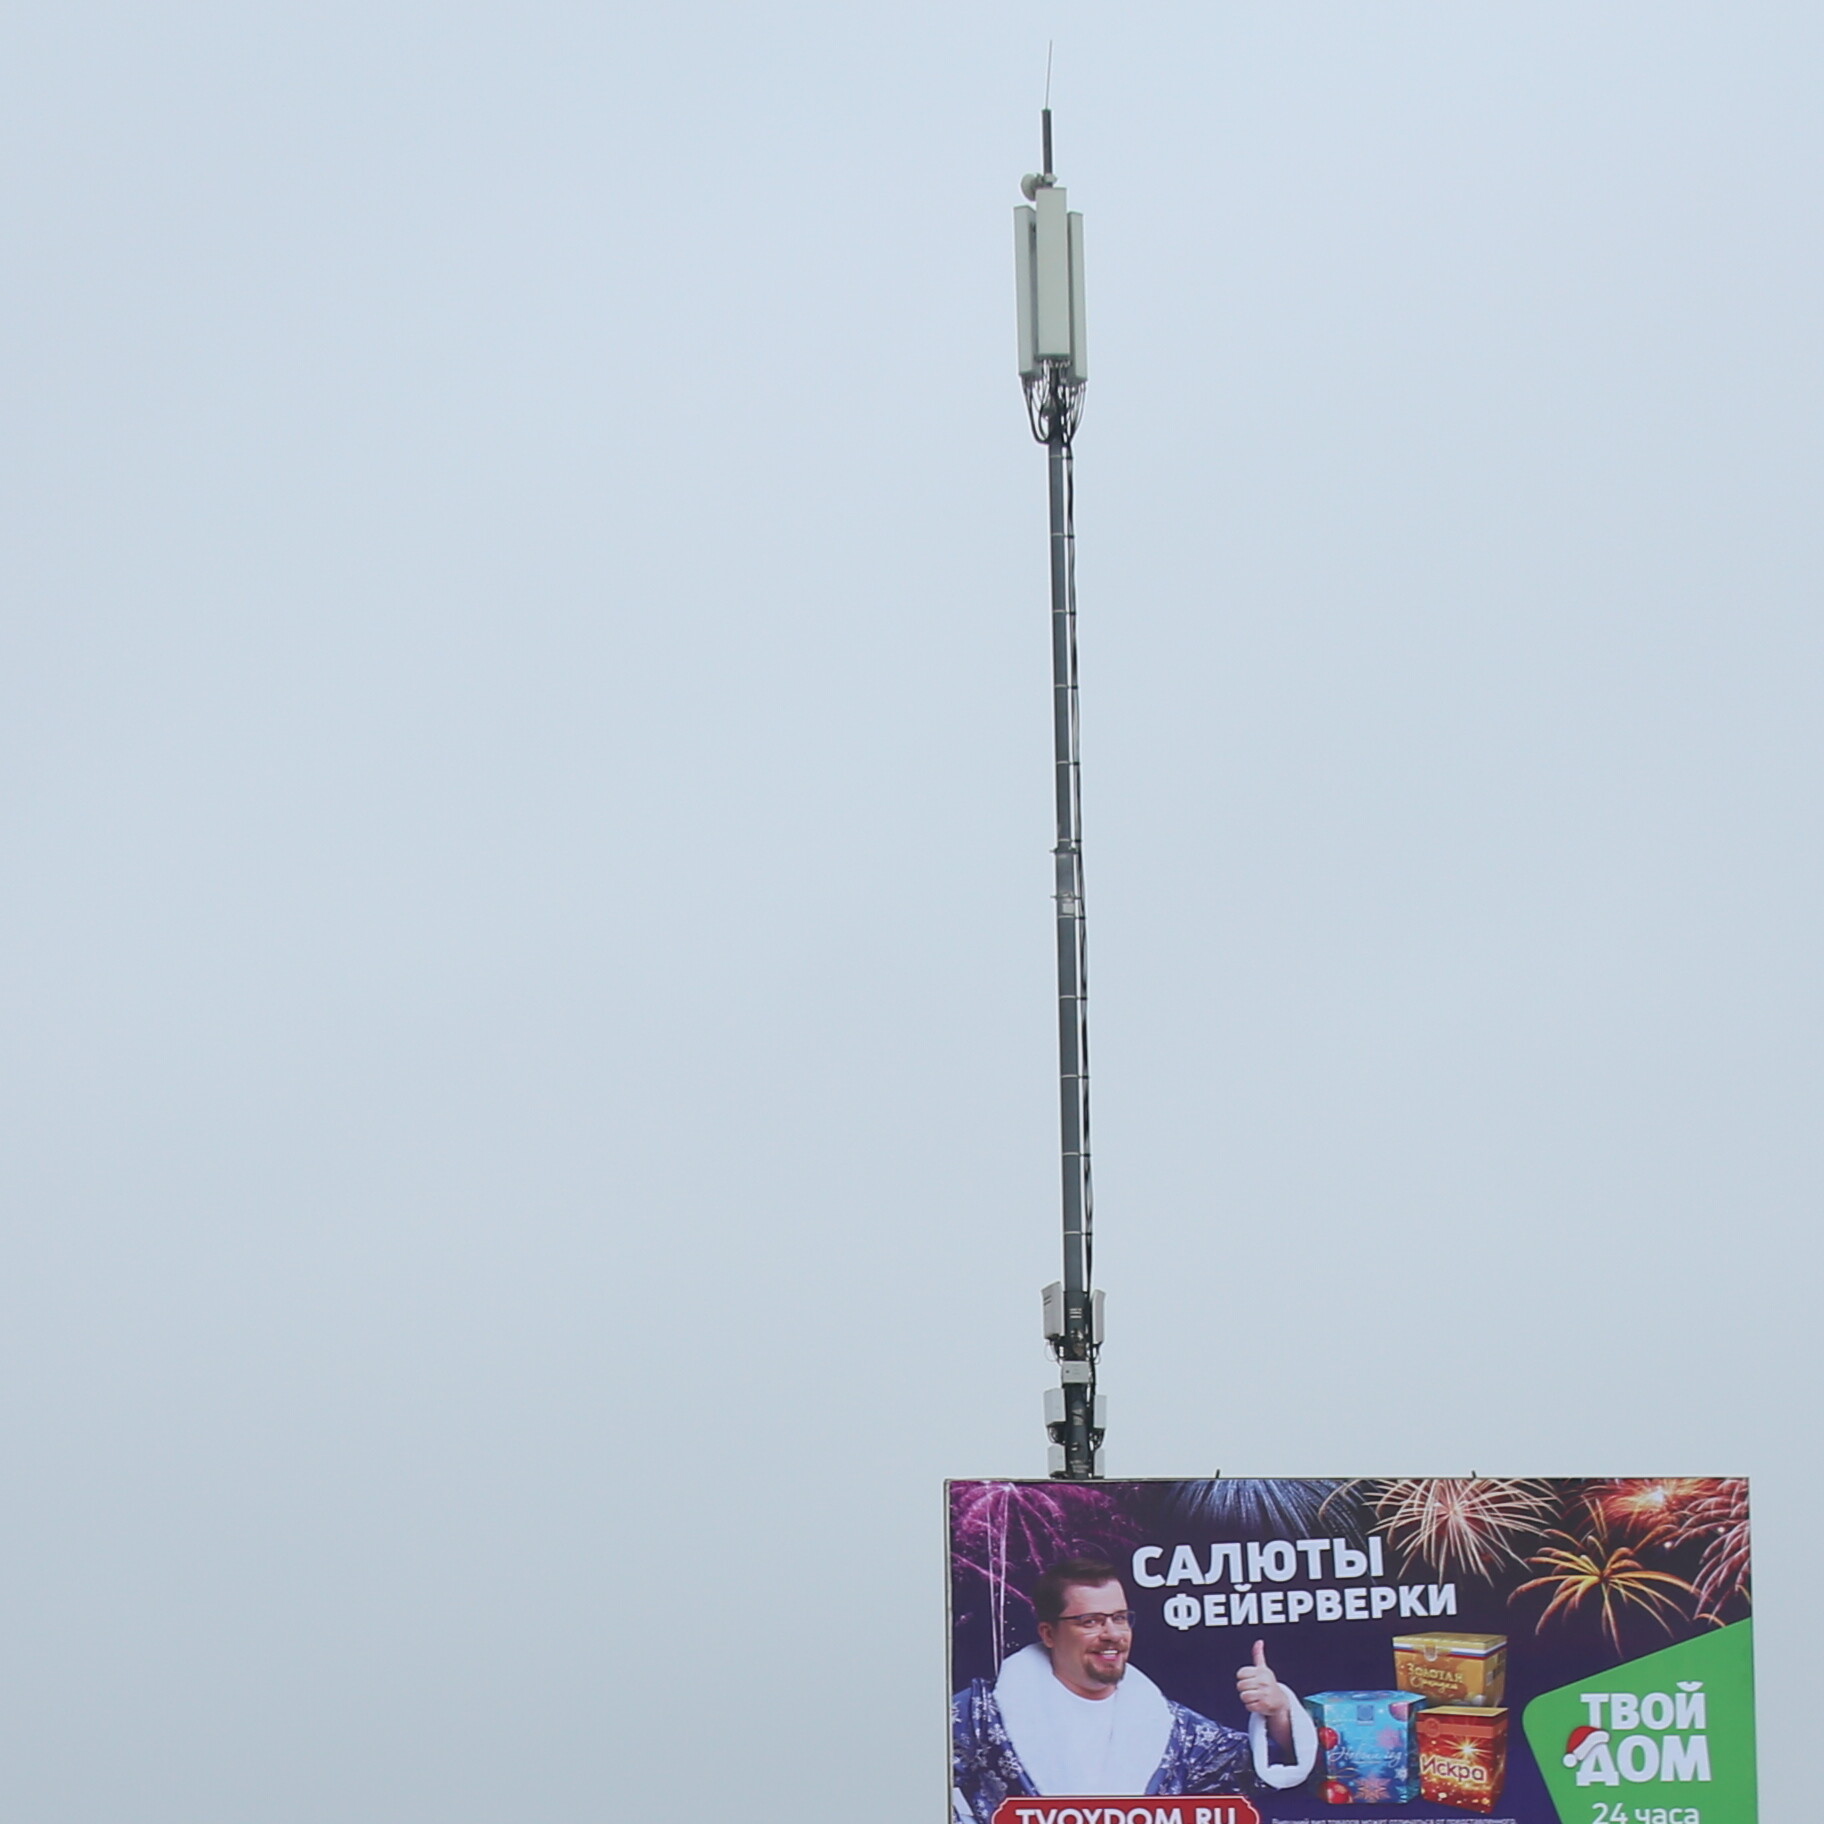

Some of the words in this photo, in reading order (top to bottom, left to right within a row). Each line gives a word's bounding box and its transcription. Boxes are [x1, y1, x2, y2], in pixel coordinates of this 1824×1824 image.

[1132, 1537, 1383, 1588] САЛЮТЫ
[1163, 1583, 1457, 1630] ФЕЙЕРВЕРКИ
[1580, 1681, 1706, 1730] ТВОЙ
[1419, 1754, 1487, 1783] Искра
[1576, 1734, 1712, 1787] ДОМ
